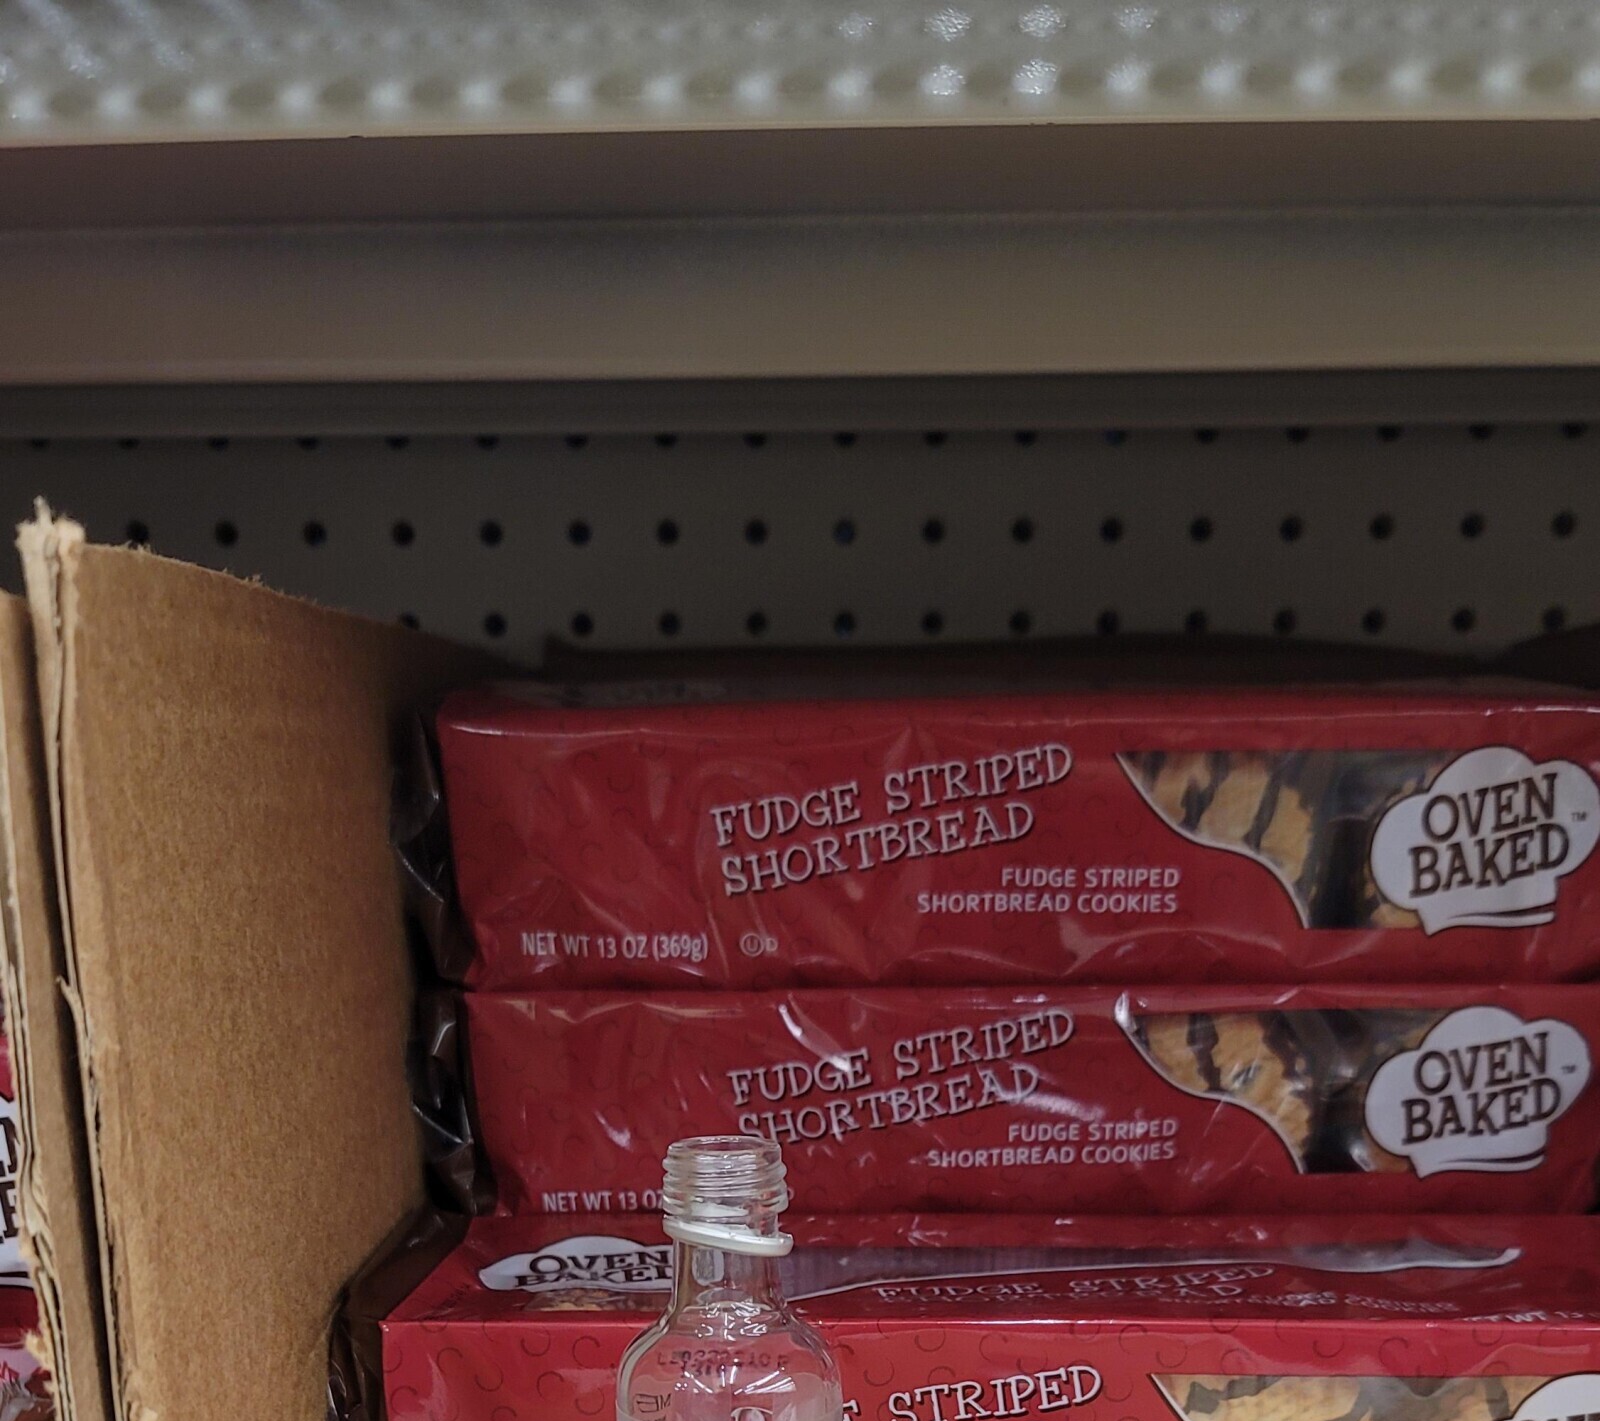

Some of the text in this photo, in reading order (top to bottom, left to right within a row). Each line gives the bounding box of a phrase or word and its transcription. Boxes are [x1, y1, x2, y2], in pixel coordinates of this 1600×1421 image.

[710, 743, 1073, 847] FUDGE STRIPED
[1422, 772, 1558, 843] OVEN
[721, 802, 1035, 897] SHORTBREAD
[1408, 823, 1570, 898] BAKED
[1001, 868, 1181, 888] FUDGE STRIPED
[917, 893, 1178, 914] SHORTBREAD COOKIES
[522, 932, 709, 962] NET WT 13 OZ (369g)
[727, 1007, 1075, 1107] FUDGE STRIPED
[1414, 1032, 1548, 1096] OVEN
[739, 1062, 1040, 1145] SHORTBREAD
[1401, 1078, 1561, 1146] BAKED
[927, 1141, 1176, 1168] SHORTBREAD COOKIES
[1008, 1119, 1178, 1143] FUDGE STRIPED
[542, 1191, 578, 1212] NET
[582, 1191, 612, 1211] WT
[618, 1191, 637, 1211] 13
[529, 1250, 669, 1274] OVEN
[1069, 1265, 1275, 1293] STRIPED
